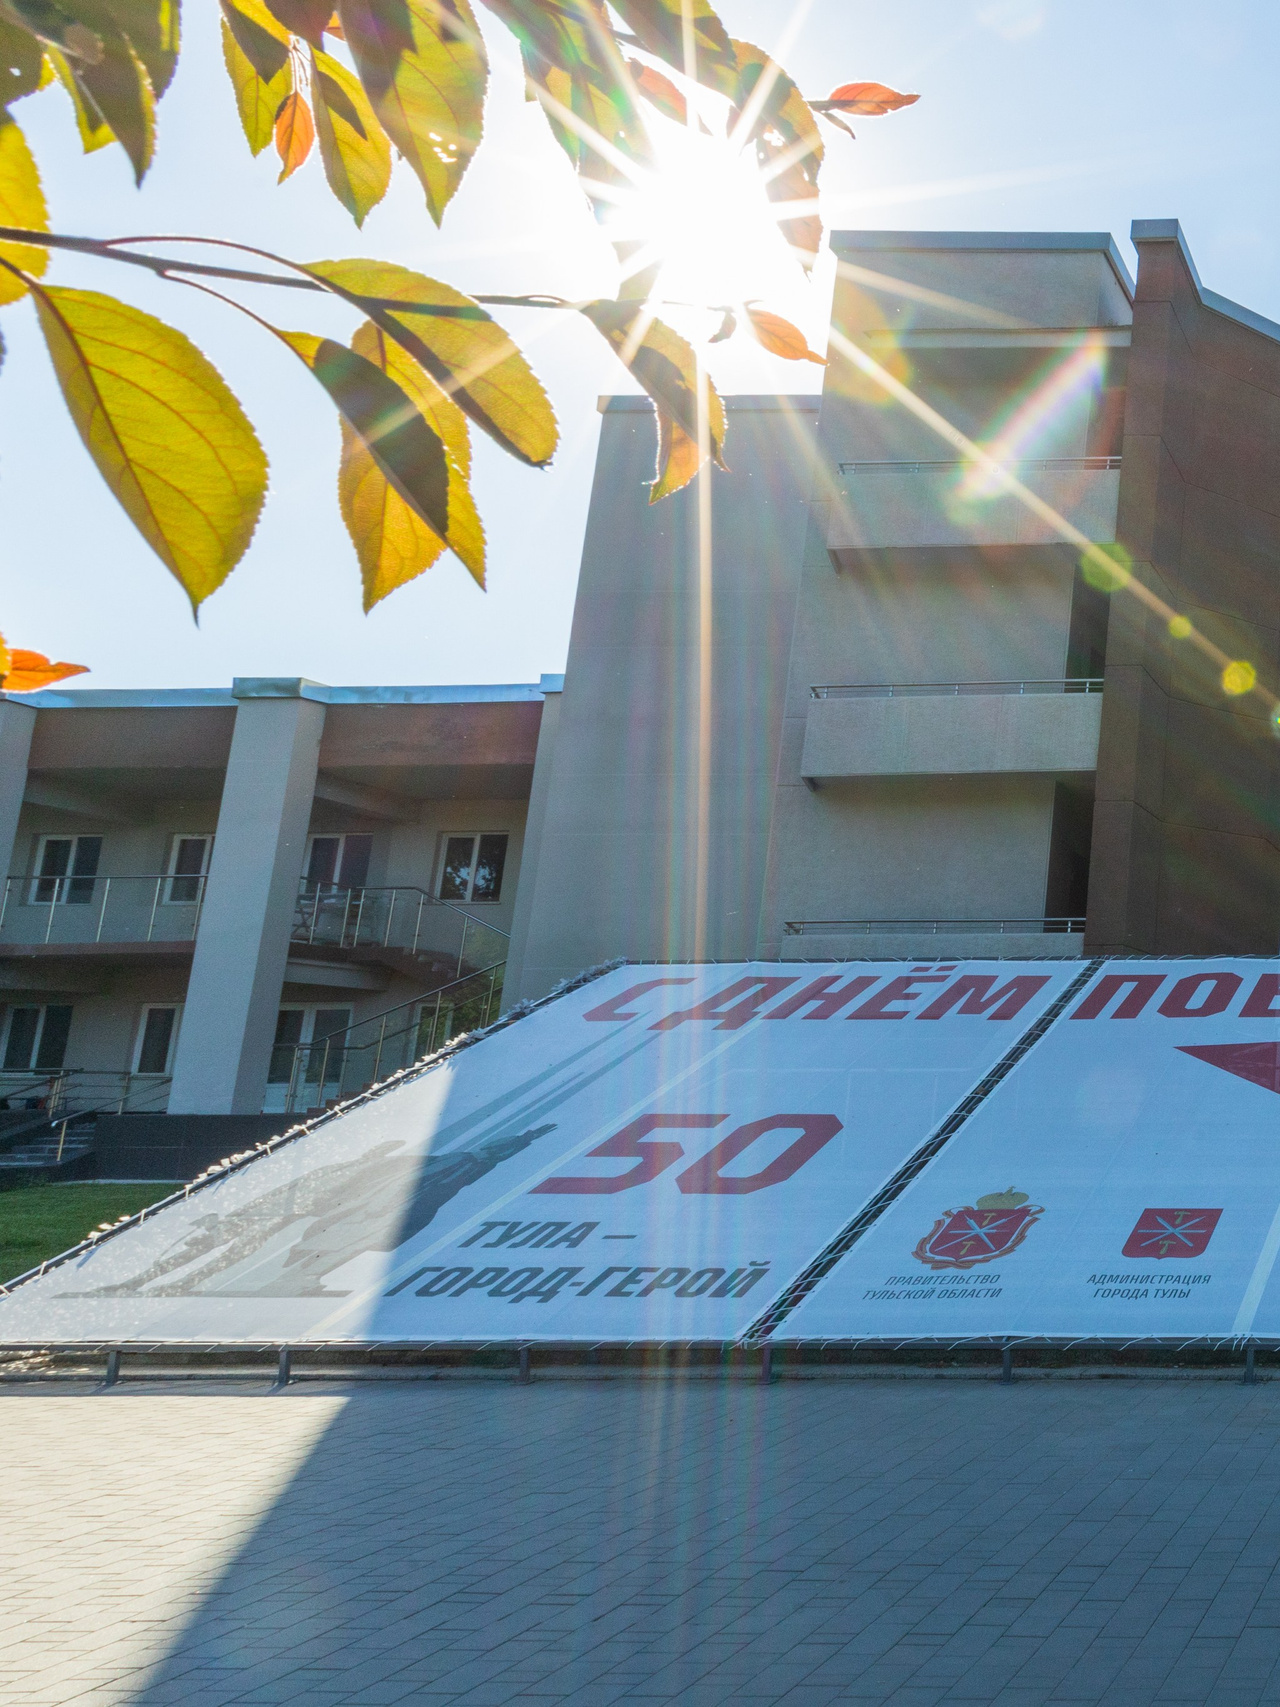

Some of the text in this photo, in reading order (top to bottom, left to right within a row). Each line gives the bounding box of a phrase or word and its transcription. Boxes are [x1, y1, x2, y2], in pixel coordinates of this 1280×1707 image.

[581, 977, 698, 1022] С
[645, 965, 1052, 1030] ДНЁМ
[527, 1114, 844, 1195] 50
[457, 1221, 599, 1248] ТУЛА
[384, 1261, 770, 1304] ГОРОД-ГЕРОЙ
[884, 1274, 1001, 1285] ПРАВИТЕЛЬСТВО
[1087, 1274, 1212, 1285] АДМИНИСТРАЦИЯ
[862, 1287, 1003, 1300] ТУЛЬСКОЙ ОБЛАСТИ
[1093, 1288, 1190, 1299] ГОРОДА ТУЛЫ
